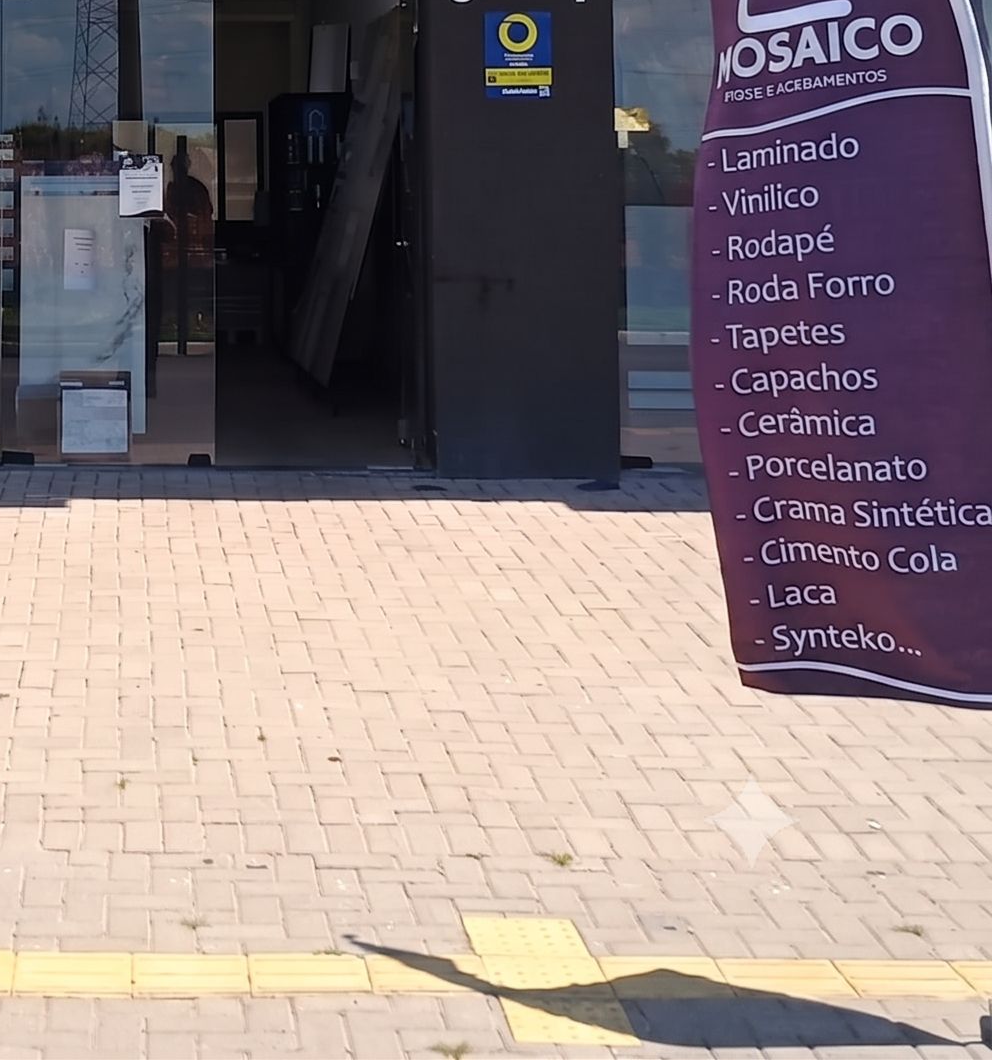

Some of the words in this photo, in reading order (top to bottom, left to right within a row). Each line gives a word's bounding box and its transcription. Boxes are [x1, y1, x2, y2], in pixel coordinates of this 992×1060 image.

[717, 14, 922, 89] MOSAICO
[721, 133, 859, 172] Laminado
[721, 184, 819, 216] Vinilico
[728, 224, 835, 261] Rodapé
[728, 273, 799, 304] Roda
[808, 272, 895, 299] Forro
[725, 321, 846, 354] Tapetes
[731, 362, 878, 397] Capachos
[738, 407, 876, 437] Cerâmica
[746, 453, 927, 482] Porcelanato
[753, 496, 846, 525] Crama
[853, 498, 992, 528] Sintética
[761, 537, 880, 571] Cimento
[888, 544, 958, 573] Cola
[767, 584, 837, 608] Laca
[772, 623, 922, 657] Synteko...
